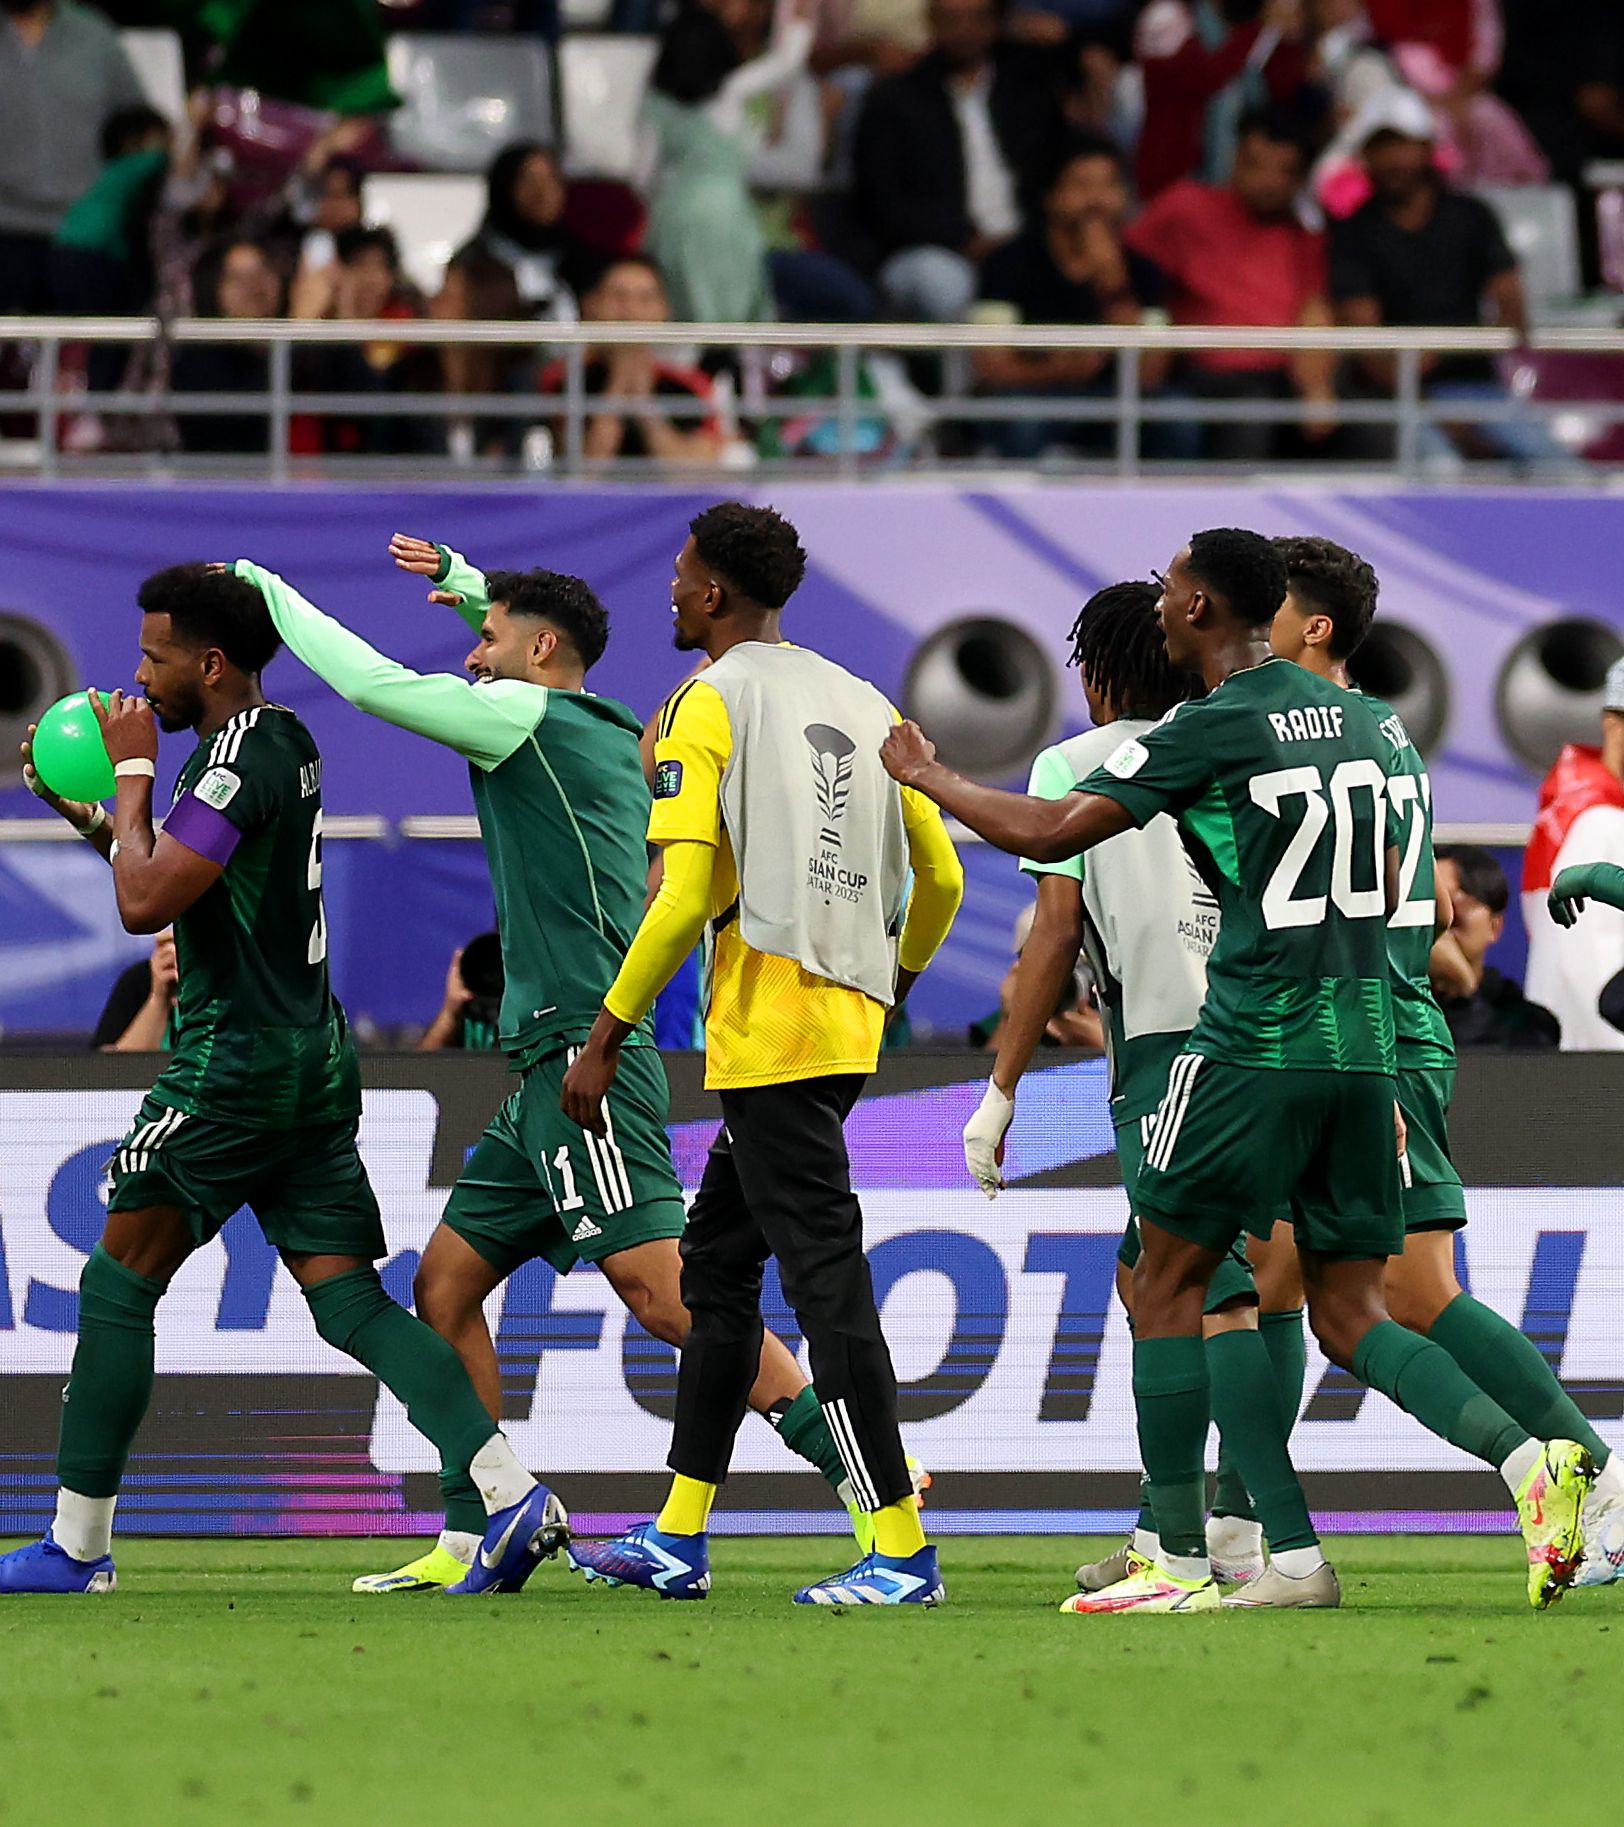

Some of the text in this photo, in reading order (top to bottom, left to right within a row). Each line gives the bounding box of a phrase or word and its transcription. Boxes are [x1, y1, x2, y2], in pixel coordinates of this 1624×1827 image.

[1268, 706, 1343, 743] RADIF
[821, 849, 838, 865] AFC
[1249, 759, 1387, 930] 20
[807, 873, 859, 903] ATAR 2023
[809, 857, 867, 889] SIAN CUP
[1177, 919, 1213, 944] ASIAN
[1195, 914, 1216, 927] AFC
